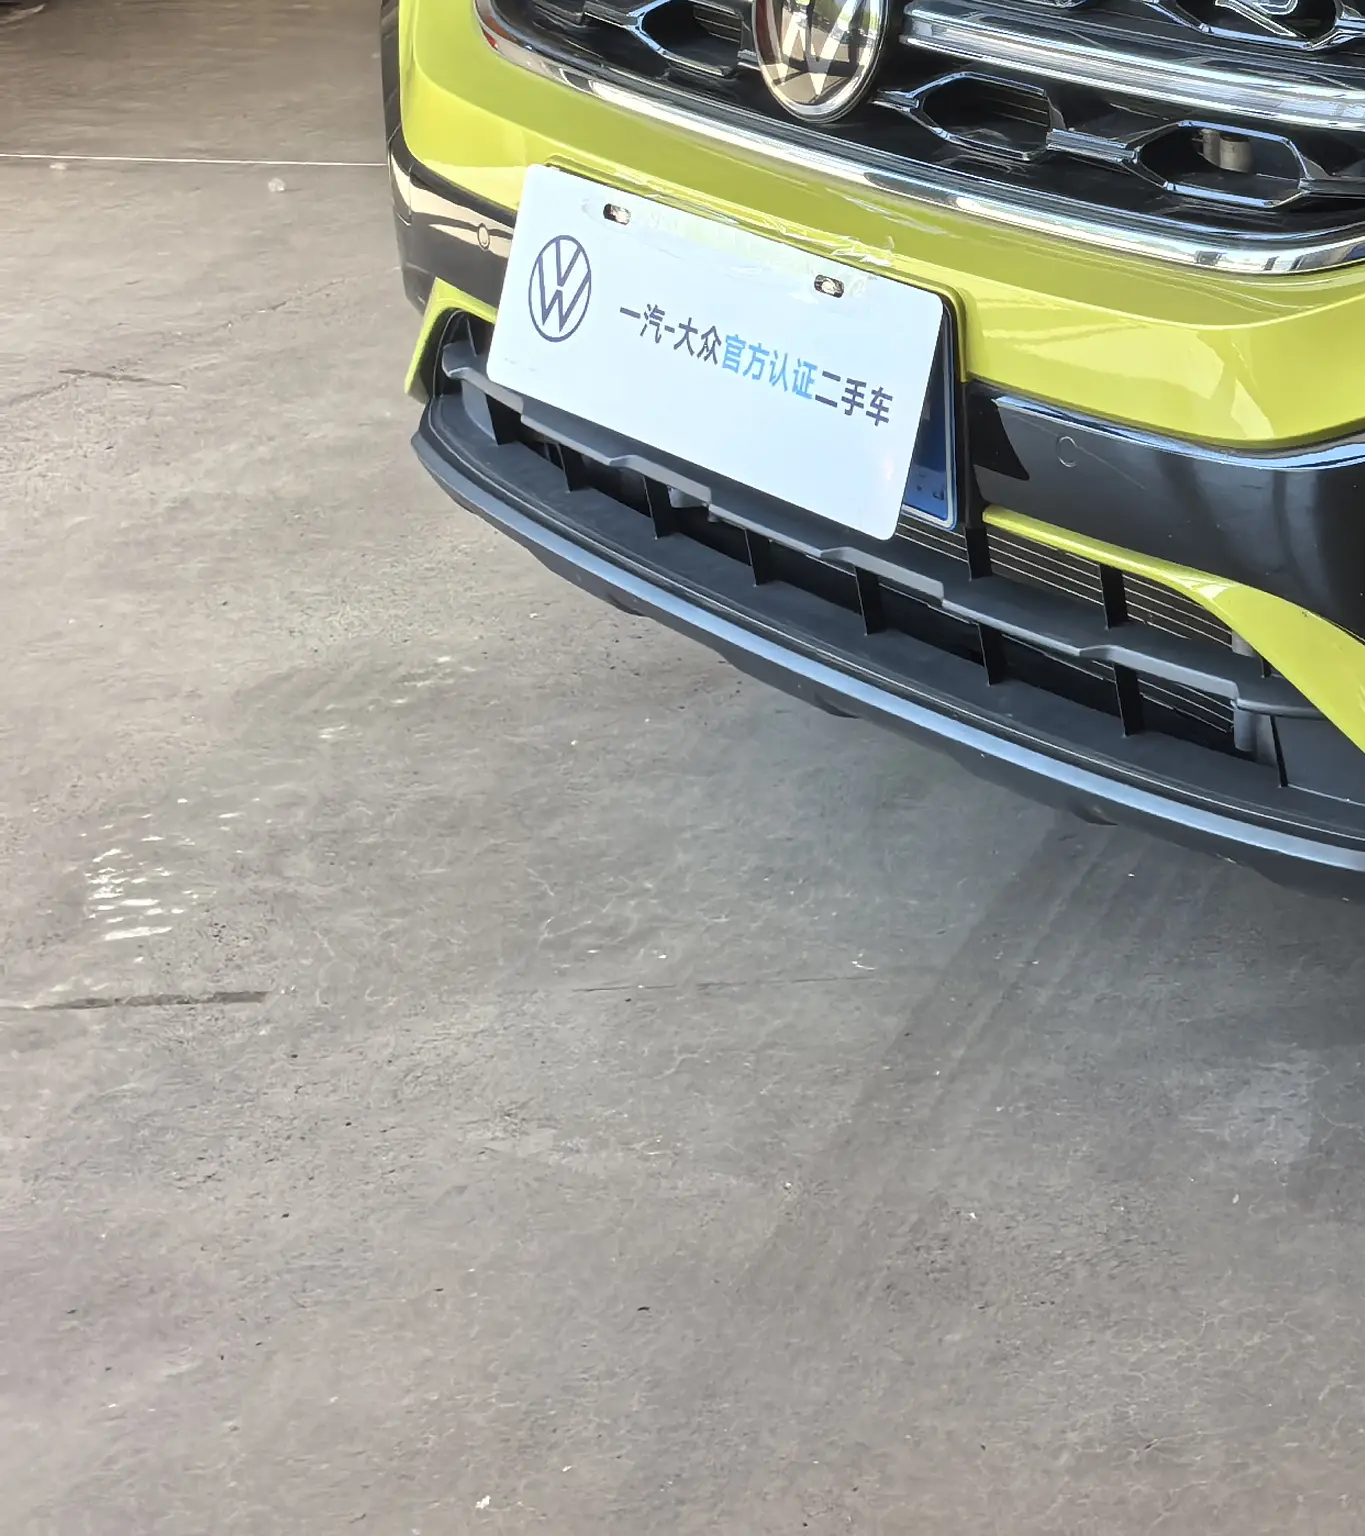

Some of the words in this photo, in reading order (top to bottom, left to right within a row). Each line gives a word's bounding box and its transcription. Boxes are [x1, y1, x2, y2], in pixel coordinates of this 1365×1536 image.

[619, 302, 894, 427] 一汽-大众官方认证二手车
